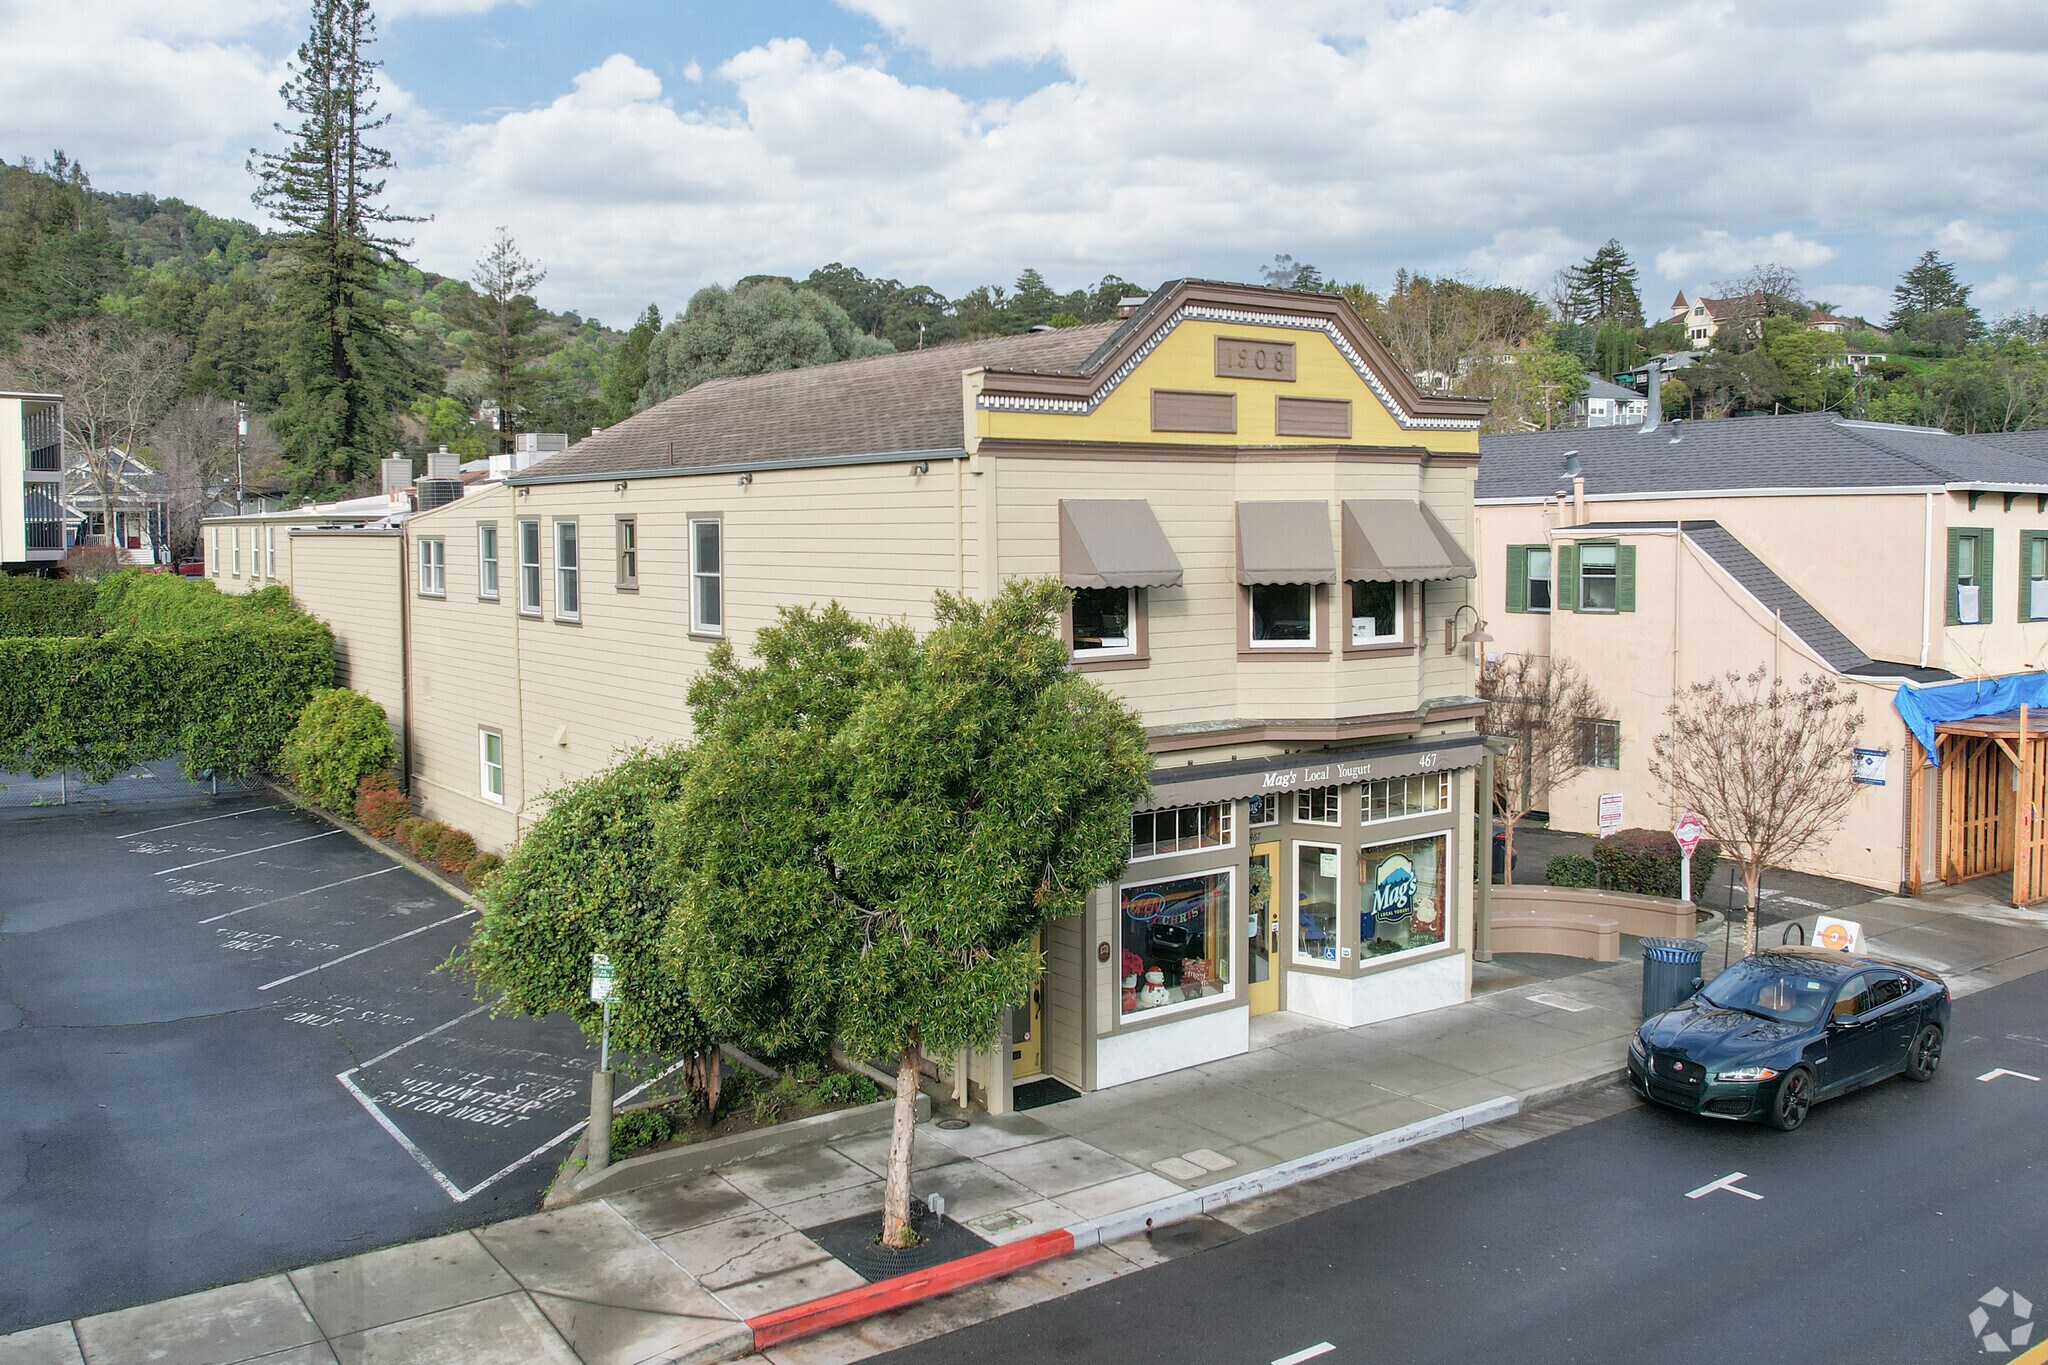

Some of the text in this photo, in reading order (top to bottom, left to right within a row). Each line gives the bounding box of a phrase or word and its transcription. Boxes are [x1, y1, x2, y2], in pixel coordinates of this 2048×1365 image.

[1226, 347, 1284, 373] 1908
[1419, 753, 1437, 768] 467
[1262, 763, 1372, 789] Mag's Local Yougurt
[1371, 872, 1418, 916] Mag's
[283, 1012, 345, 1028] ONLY
[401, 1078, 541, 1114] VOLUNTEER
[414, 1099, 456, 1115] OR
[448, 1105, 532, 1128] NIGHT
